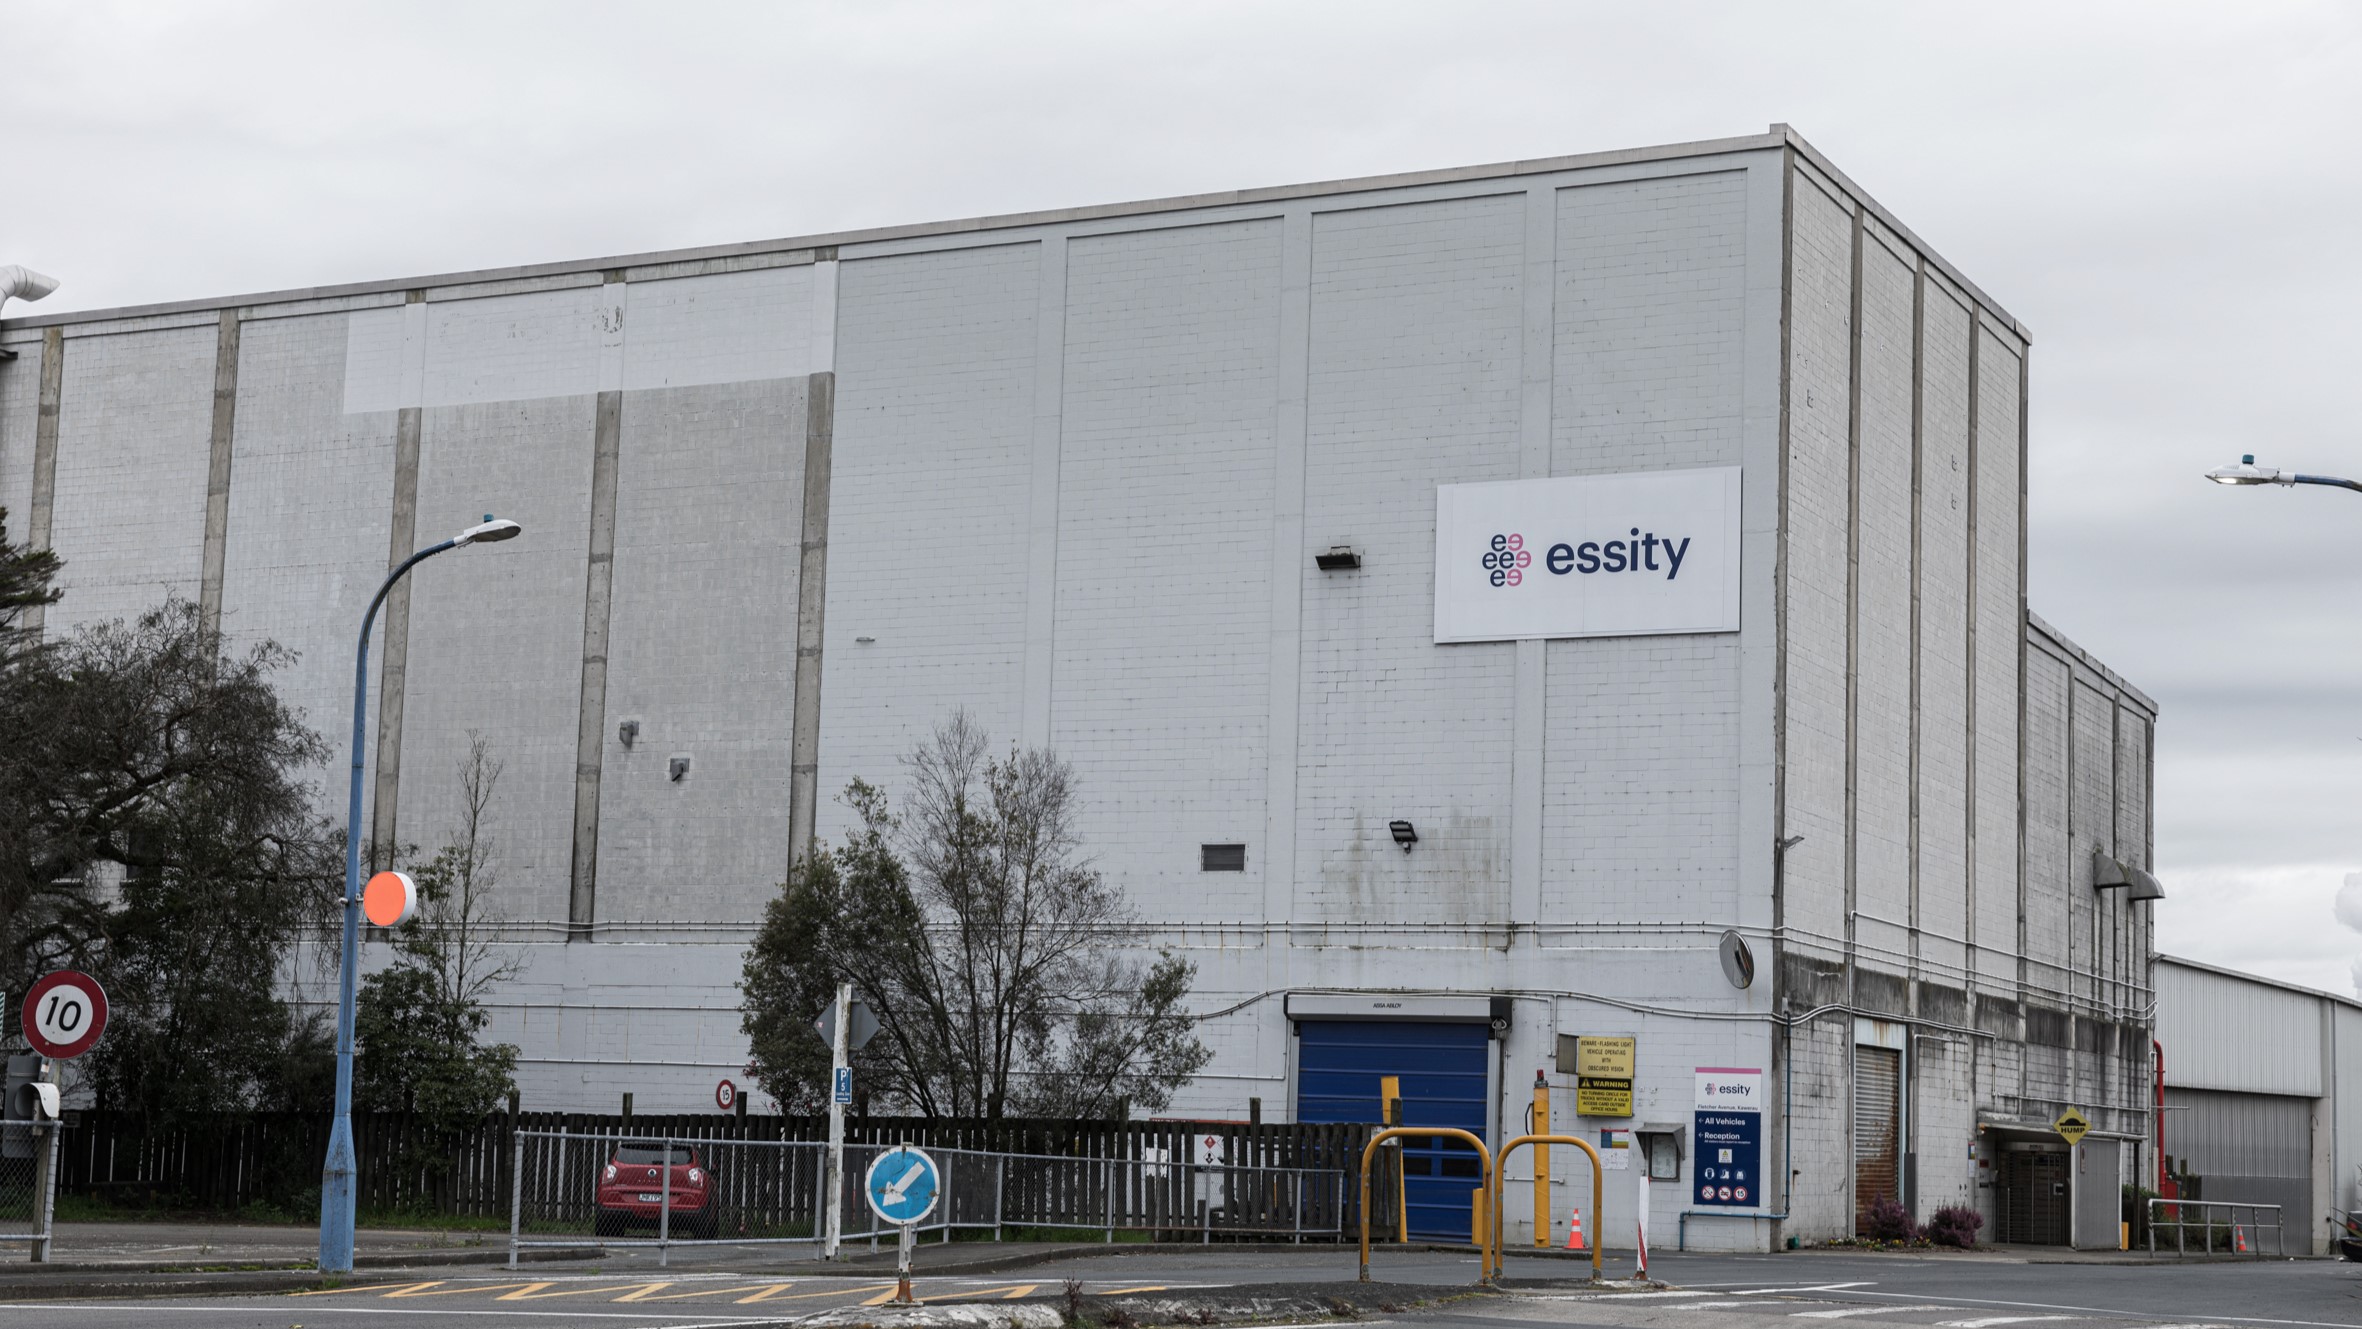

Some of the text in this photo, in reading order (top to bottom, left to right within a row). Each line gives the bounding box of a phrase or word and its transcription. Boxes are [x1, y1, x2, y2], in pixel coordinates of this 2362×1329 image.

[1546, 527, 1691, 580] essity
[45, 996, 82, 1032] 10
[840, 1070, 846, 1081] P
[841, 1082, 846, 1091] 5
[1720, 1084, 1750, 1096] essity
[722, 1090, 730, 1100] 15
[1704, 1132, 1740, 1140] Reception
